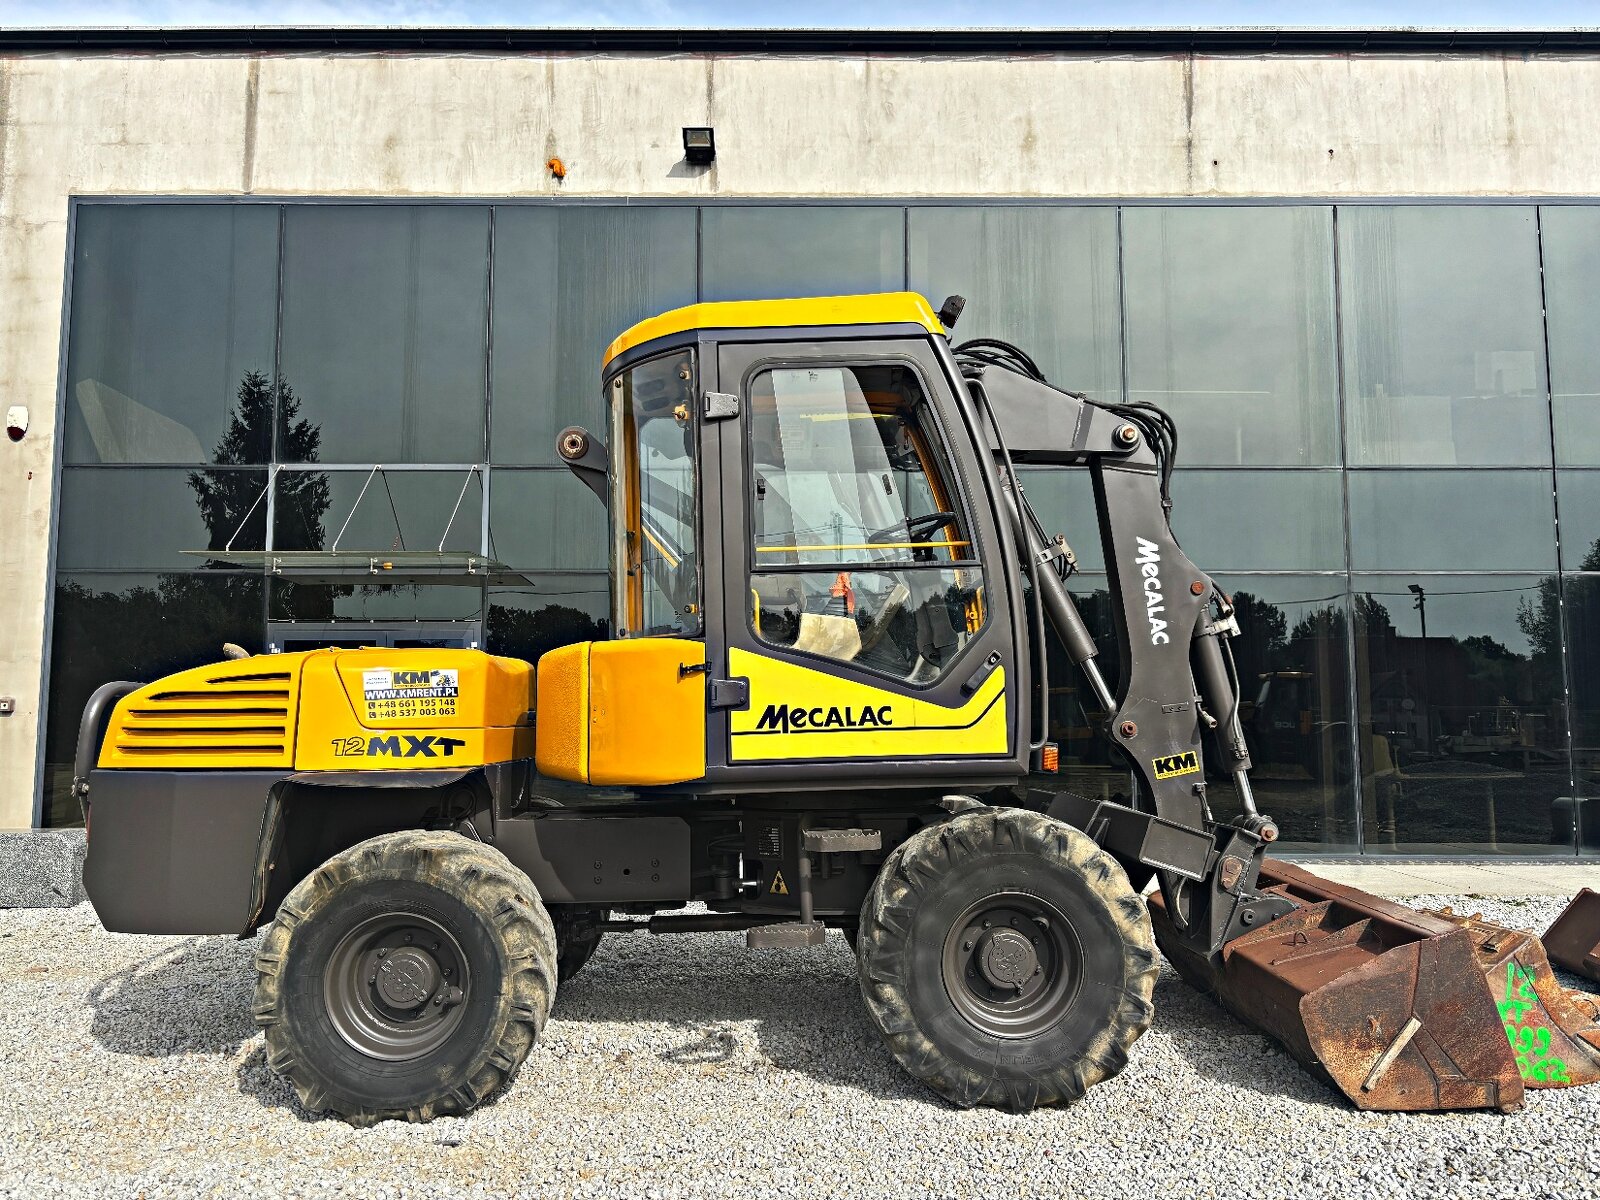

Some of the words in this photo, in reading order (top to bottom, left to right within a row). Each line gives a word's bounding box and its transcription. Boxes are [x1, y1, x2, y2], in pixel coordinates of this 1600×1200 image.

[394, 671, 430, 684] KM
[365, 687, 458, 700] WWW.KMRENT.PL
[378, 701, 396, 709] +48
[399, 700, 416, 708] 661
[420, 699, 436, 707] 195
[379, 710, 397, 718] +48
[399, 709, 417, 717] 537
[420, 708, 437, 716] 003
[439, 707, 456, 715] 063
[1154, 752, 1197, 774] KM
